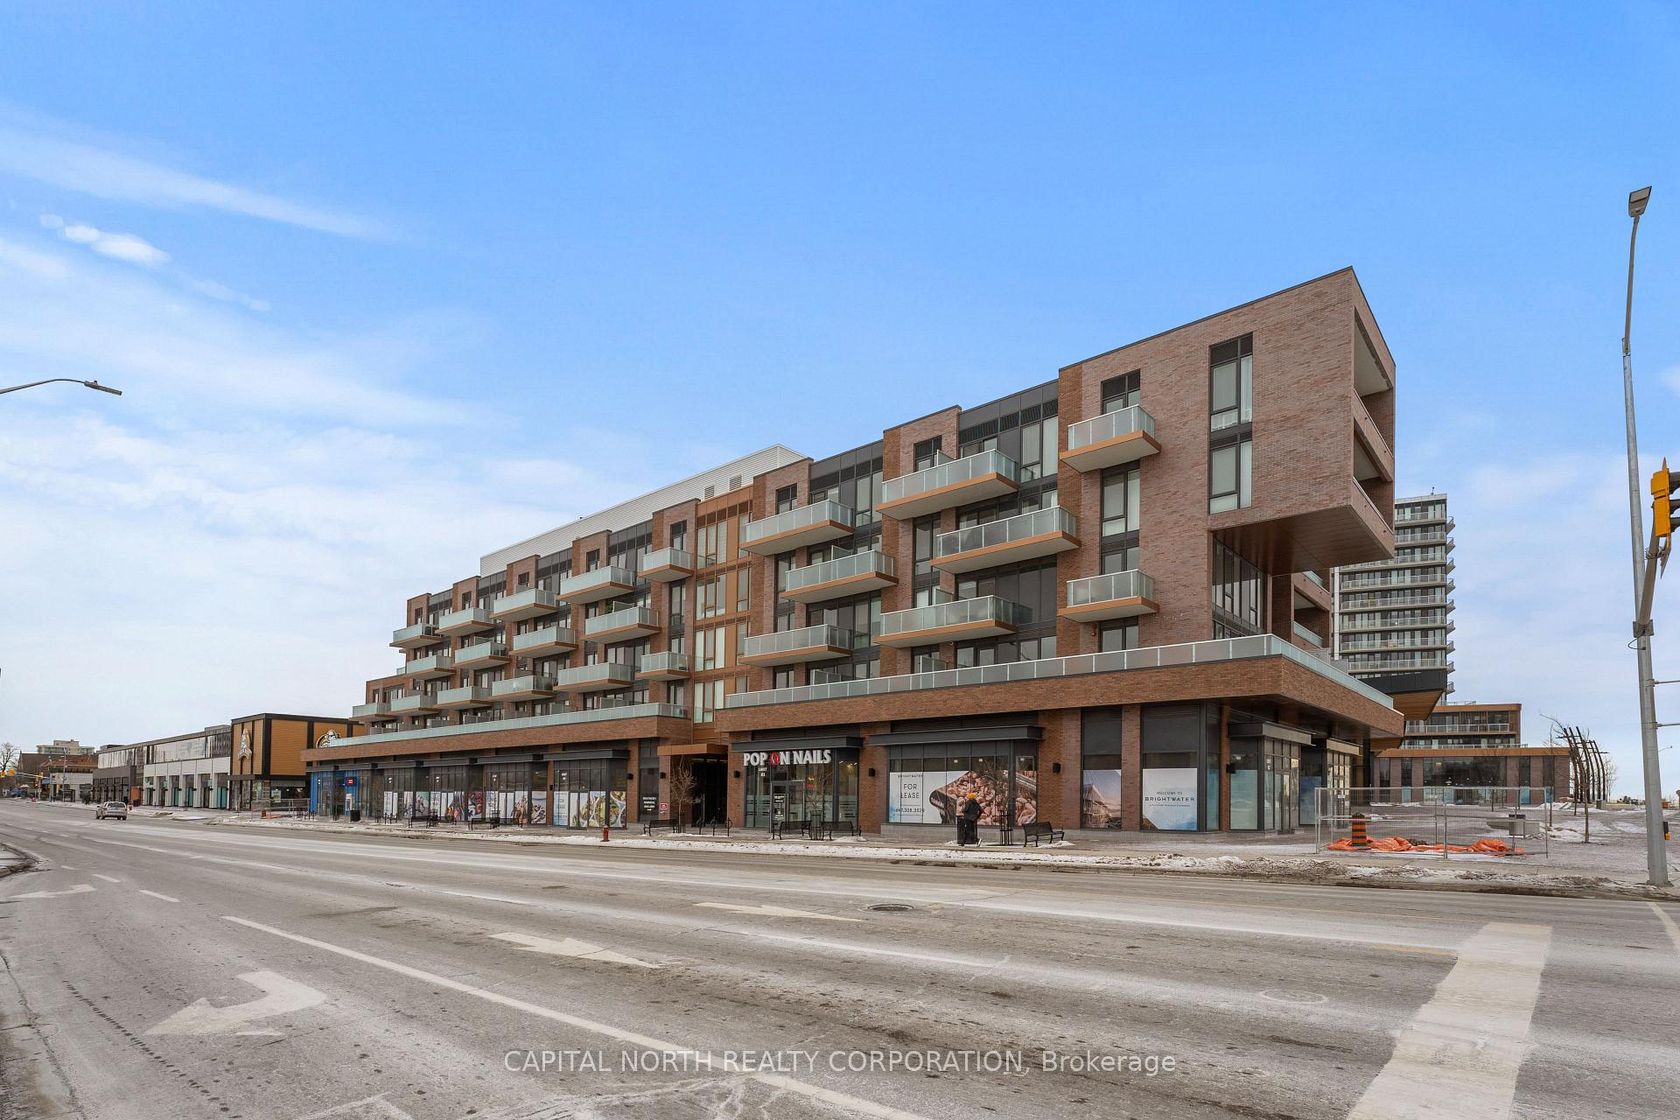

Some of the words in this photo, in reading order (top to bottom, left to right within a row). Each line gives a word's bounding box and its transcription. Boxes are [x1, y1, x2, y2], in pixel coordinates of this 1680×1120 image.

[743, 752, 768, 767] POP
[769, 751, 791, 768] ON
[792, 749, 832, 765] NAILS
